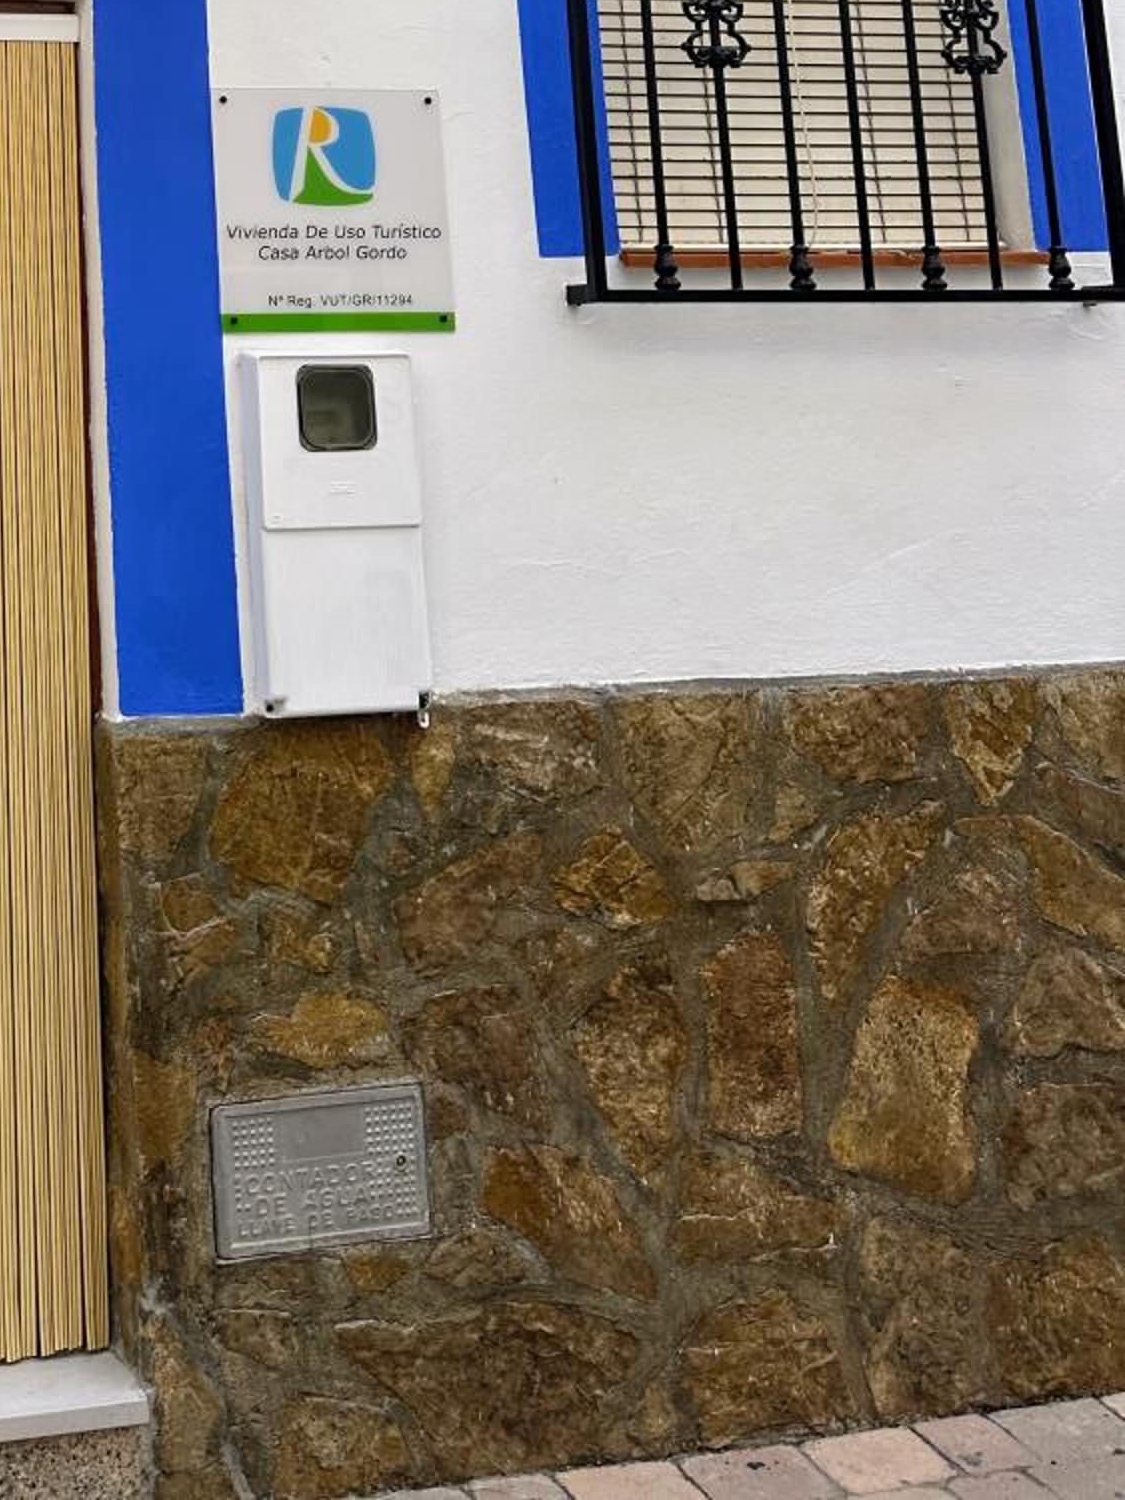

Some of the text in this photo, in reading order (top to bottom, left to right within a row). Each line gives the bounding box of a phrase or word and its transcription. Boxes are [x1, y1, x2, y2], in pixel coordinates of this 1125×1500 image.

[226, 223, 443, 240] Vivienda De Uso Turístico
[258, 245, 408, 261] Casa Arbol Gordo
[245, 1161, 375, 1194] CONTADOR
[256, 1185, 368, 1216] DE AGUA
[308, 1209, 334, 1229] DE
